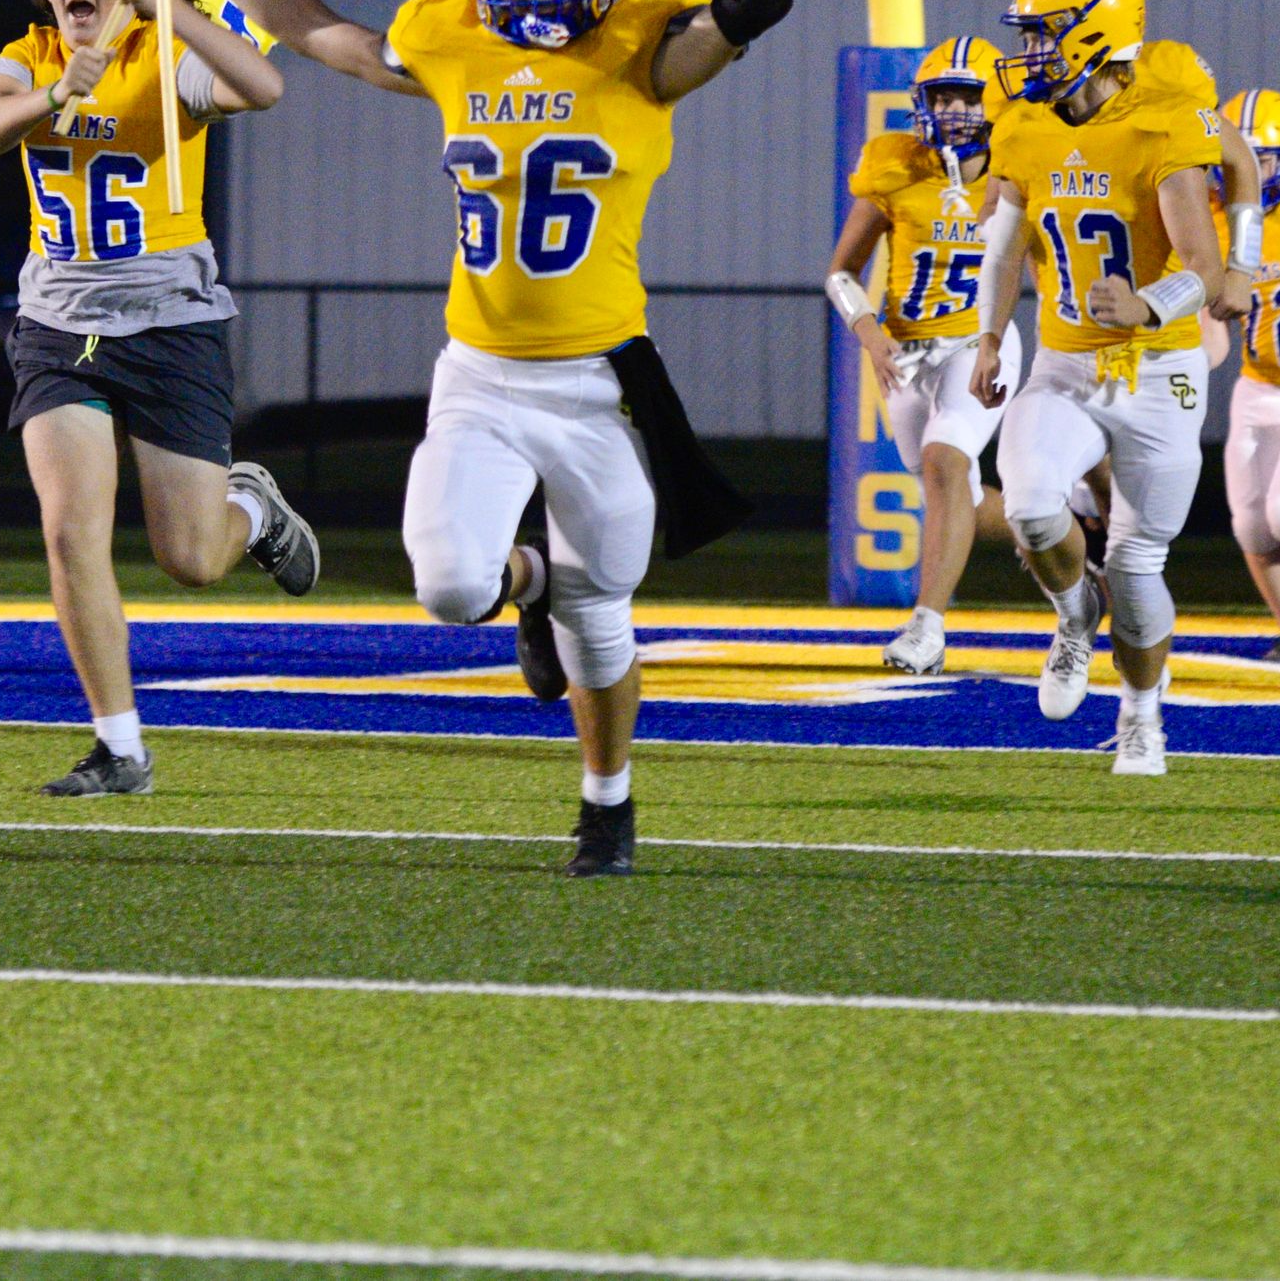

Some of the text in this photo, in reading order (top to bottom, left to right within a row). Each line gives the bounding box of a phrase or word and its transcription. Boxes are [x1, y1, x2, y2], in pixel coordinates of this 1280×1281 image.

[466, 89, 576, 124] RAMS
[25, 145, 149, 263] 56
[443, 134, 617, 279] 66
[1051, 171, 1111, 198] RAMS
[932, 220, 986, 243] RAM
[1039, 207, 1141, 329] 13
[900, 247, 985, 322] 15
